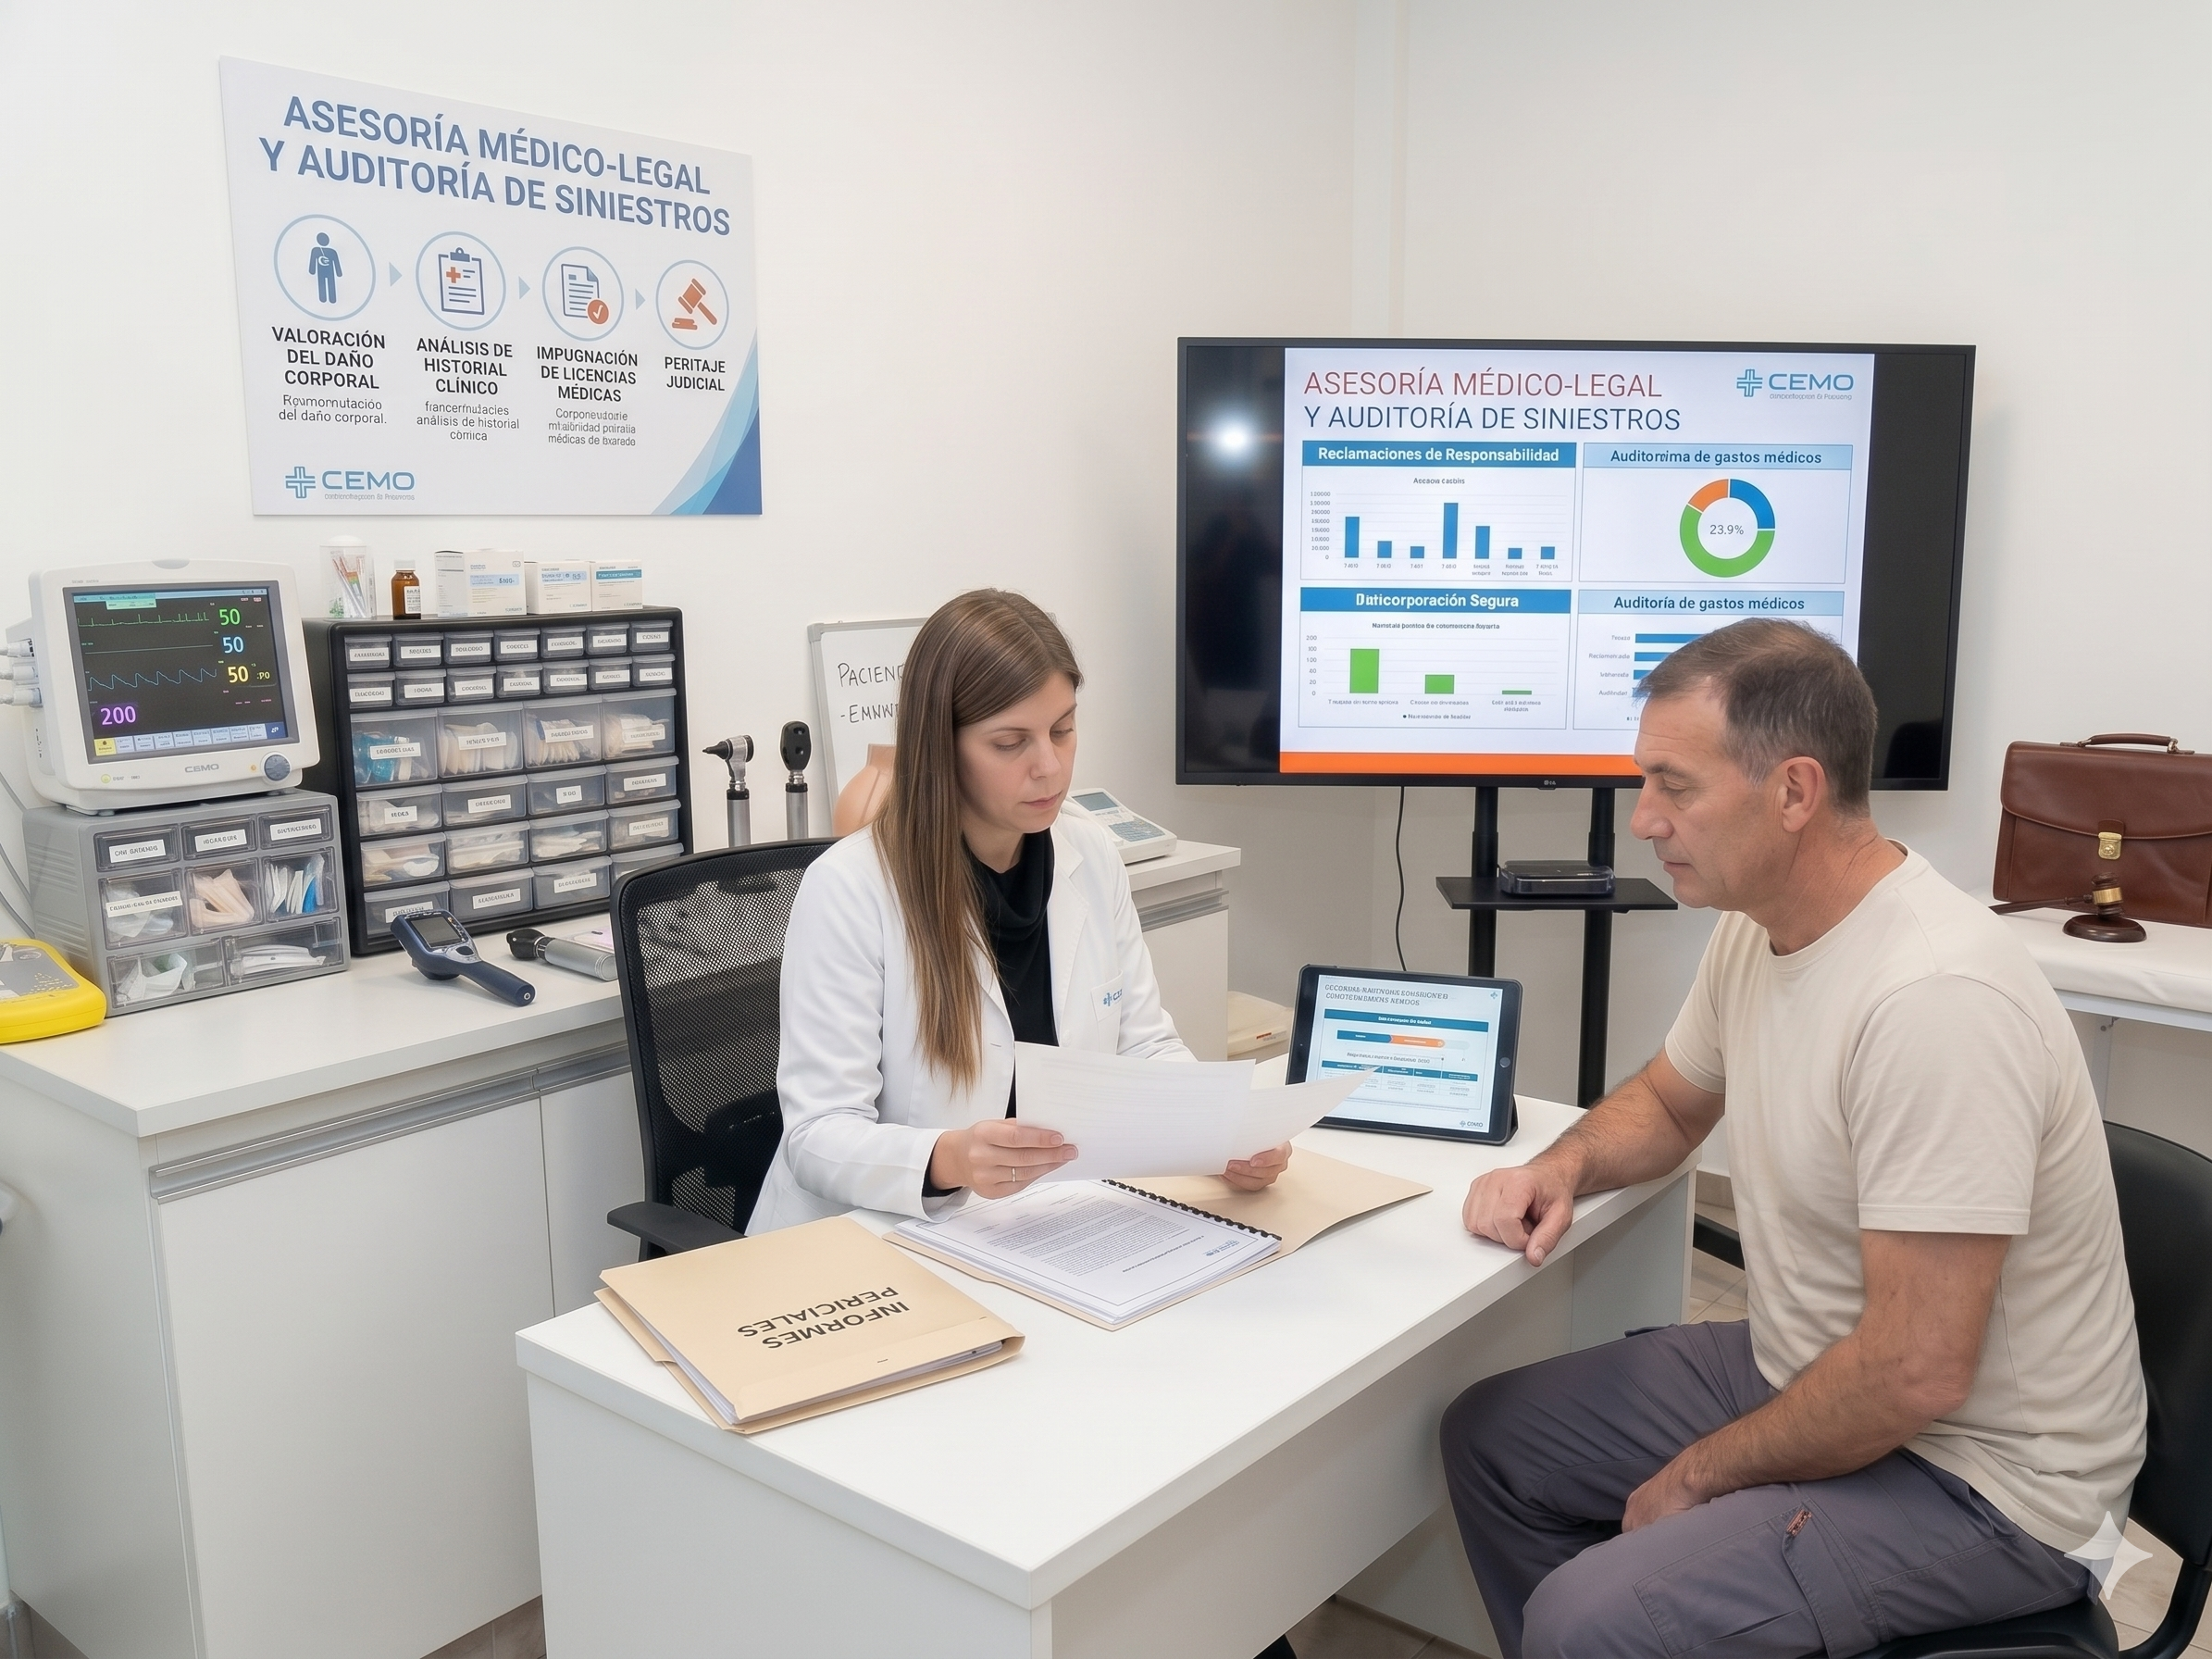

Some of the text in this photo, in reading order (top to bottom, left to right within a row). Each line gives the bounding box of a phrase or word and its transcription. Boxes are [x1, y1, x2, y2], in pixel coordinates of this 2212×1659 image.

[283, 96, 710, 194] ASESORÍA MÉDICO-LEGAL
[259, 137, 730, 236] Y AUDITORÍA DE SINIESTROS
[272, 327, 385, 349] VALORACIÓN
[416, 336, 513, 358] ANÁLISIS DE
[287, 349, 374, 368] DEL DAÑO
[537, 346, 639, 367] IMPUGNACIÓN
[665, 356, 726, 373] PERITAJE
[424, 358, 507, 377] HISTORIAL
[541, 366, 637, 384] DE LICENCIAS
[285, 370, 379, 389] CORPORAL
[436, 377, 498, 395] CLÍNICO
[666, 376, 725, 392] JUDICIAL
[1303, 367, 1662, 397] ASESORÍA MÉDICO-LEGAL
[1769, 373, 1854, 391] CEMO
[557, 383, 622, 402] MÉDICAS
[279, 409, 387, 425] del daño corporal.
[462, 417, 475, 427] de
[478, 417, 519, 429] historial
[1304, 401, 1681, 430] Y AUDITORÍA DE SINIESTROS
[548, 433, 586, 445] médicas
[588, 434, 600, 445] de
[1318, 447, 1560, 463] Reclamaciones de Responsabilidad
[1694, 450, 1710, 463] de
[1714, 452, 1759, 466] gastos
[1764, 451, 1822, 464] médicos
[322, 470, 415, 491] CEMO
[1709, 524, 1744, 535] 23.9%
[1470, 593, 1520, 610] Segura
[1614, 596, 1805, 612] Auditoría de gastos médicos
[218, 608, 241, 626] 50
[222, 636, 244, 654] 50
[228, 666, 249, 683] 50
[100, 705, 137, 726] 200
[184, 763, 219, 773] CEMO
[738, 1286, 899, 1338] PERICIALES
[762, 1301, 910, 1349] INFORMES
